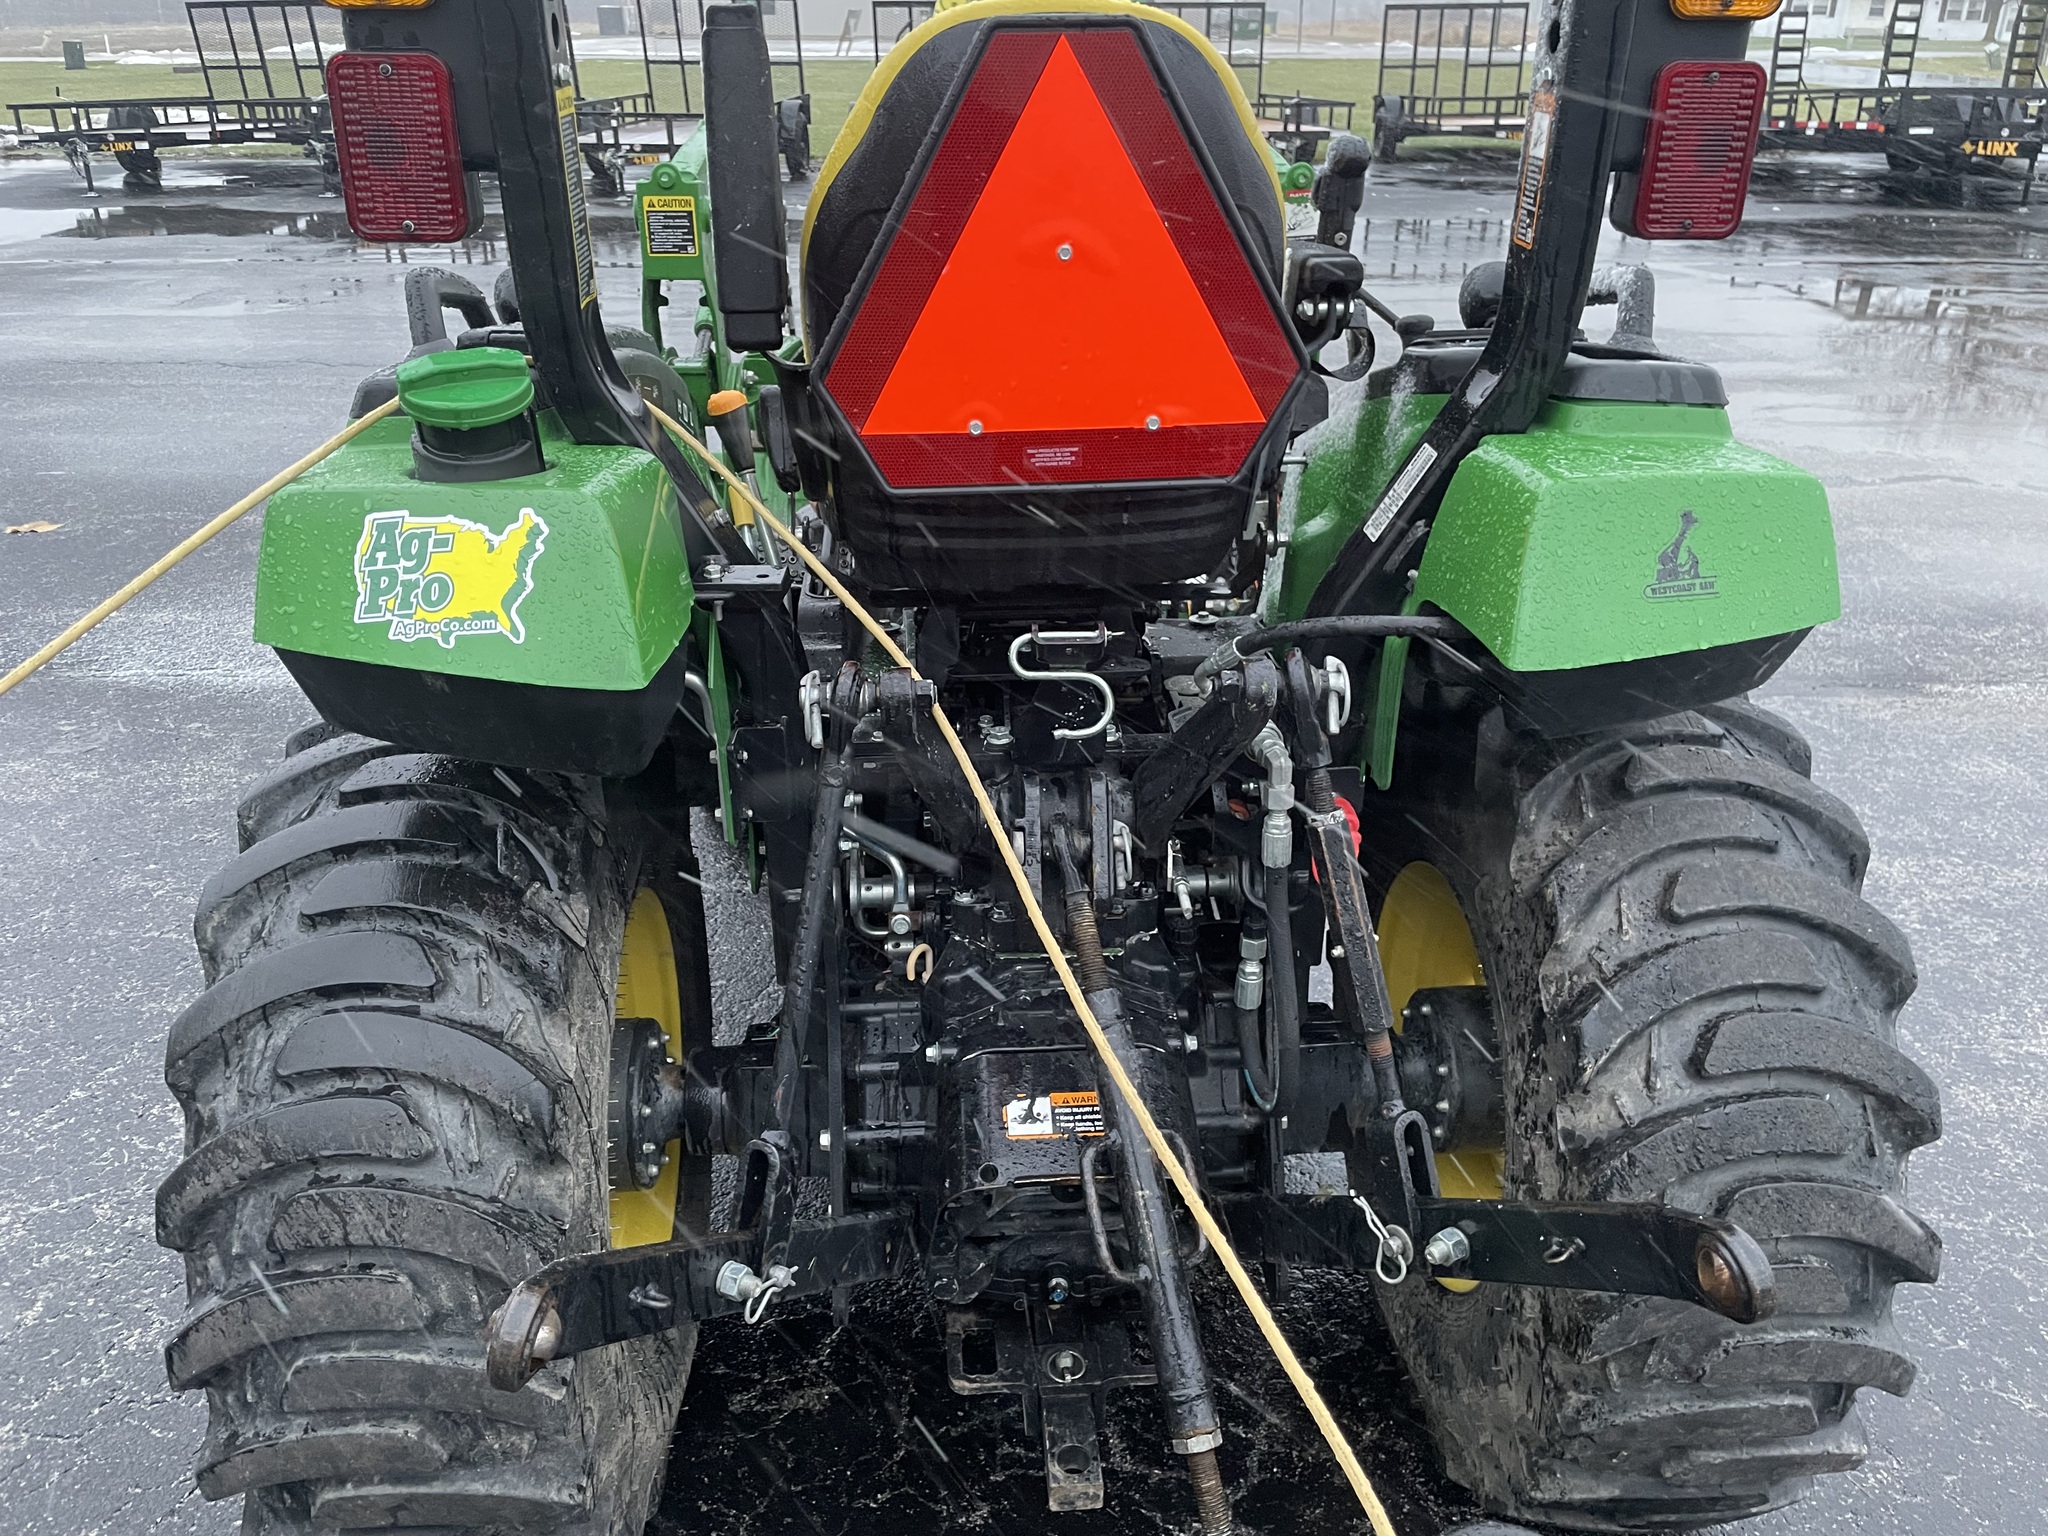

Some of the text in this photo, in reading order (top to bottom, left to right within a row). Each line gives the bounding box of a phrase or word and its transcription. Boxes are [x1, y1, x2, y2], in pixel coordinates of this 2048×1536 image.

[110, 142, 134, 151] LINX
[1977, 140, 2019, 157] LINX
[657, 198, 692, 208] CAUTION
[361, 516, 456, 576] Ag-
[358, 567, 455, 621] Pro
[1650, 583, 1696, 596] WESTCOAST
[394, 618, 498, 638] AgProCo.com
[1071, 1095, 1098, 1104] WARN
